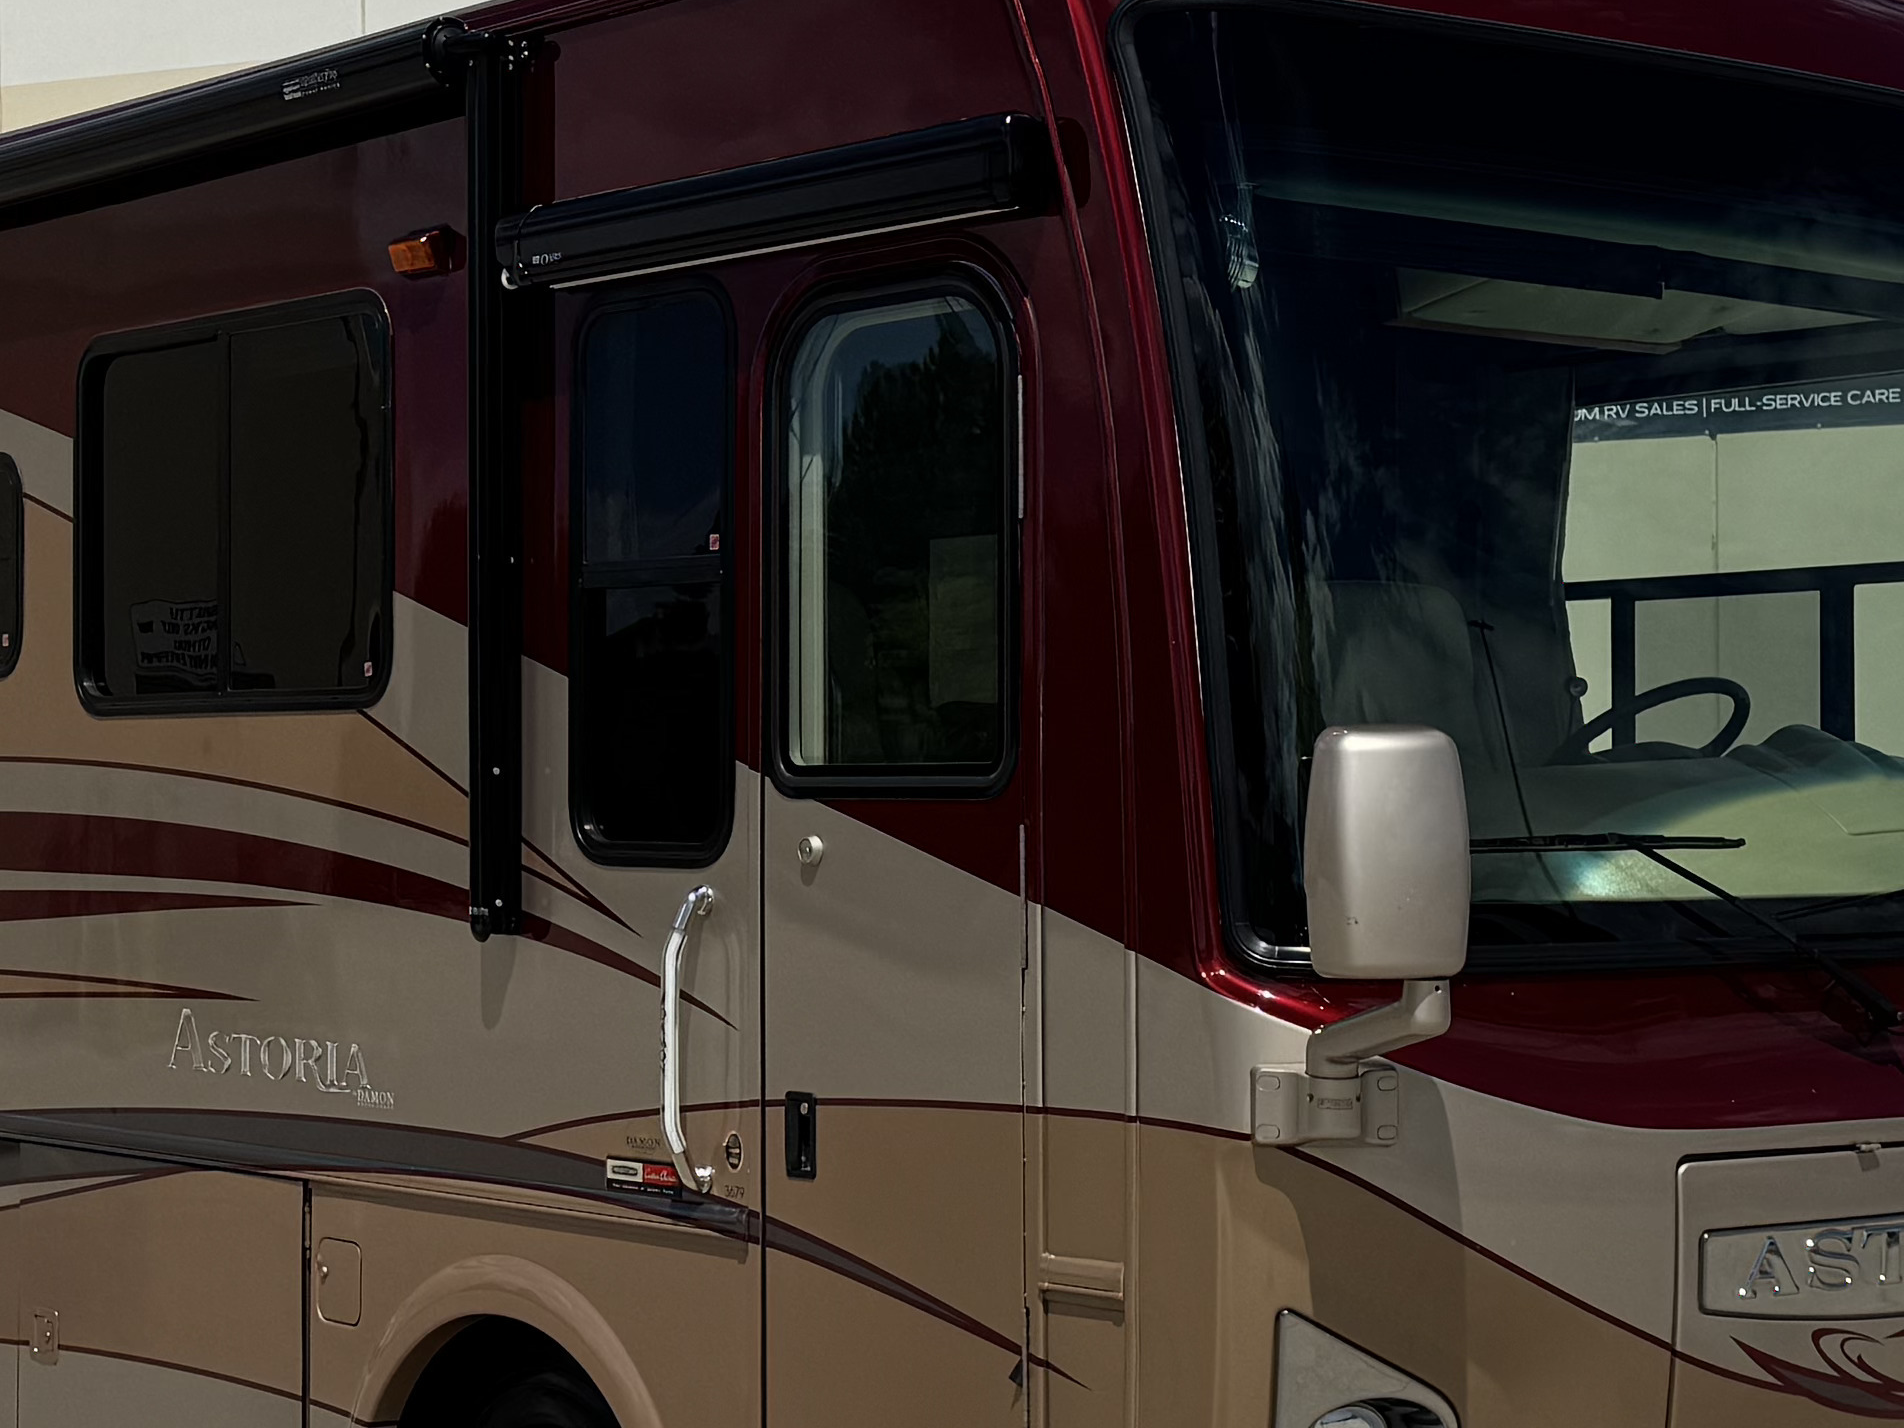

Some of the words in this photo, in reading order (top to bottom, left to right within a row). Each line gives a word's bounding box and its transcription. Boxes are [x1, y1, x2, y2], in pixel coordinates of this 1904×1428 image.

[1604, 404, 1630, 420] RV
[1635, 400, 1698, 418] SALES
[1711, 392, 1840, 413] FULL-SERVICE
[1846, 388, 1901, 405] CARE
[167, 1008, 372, 1092] ASTORIA
